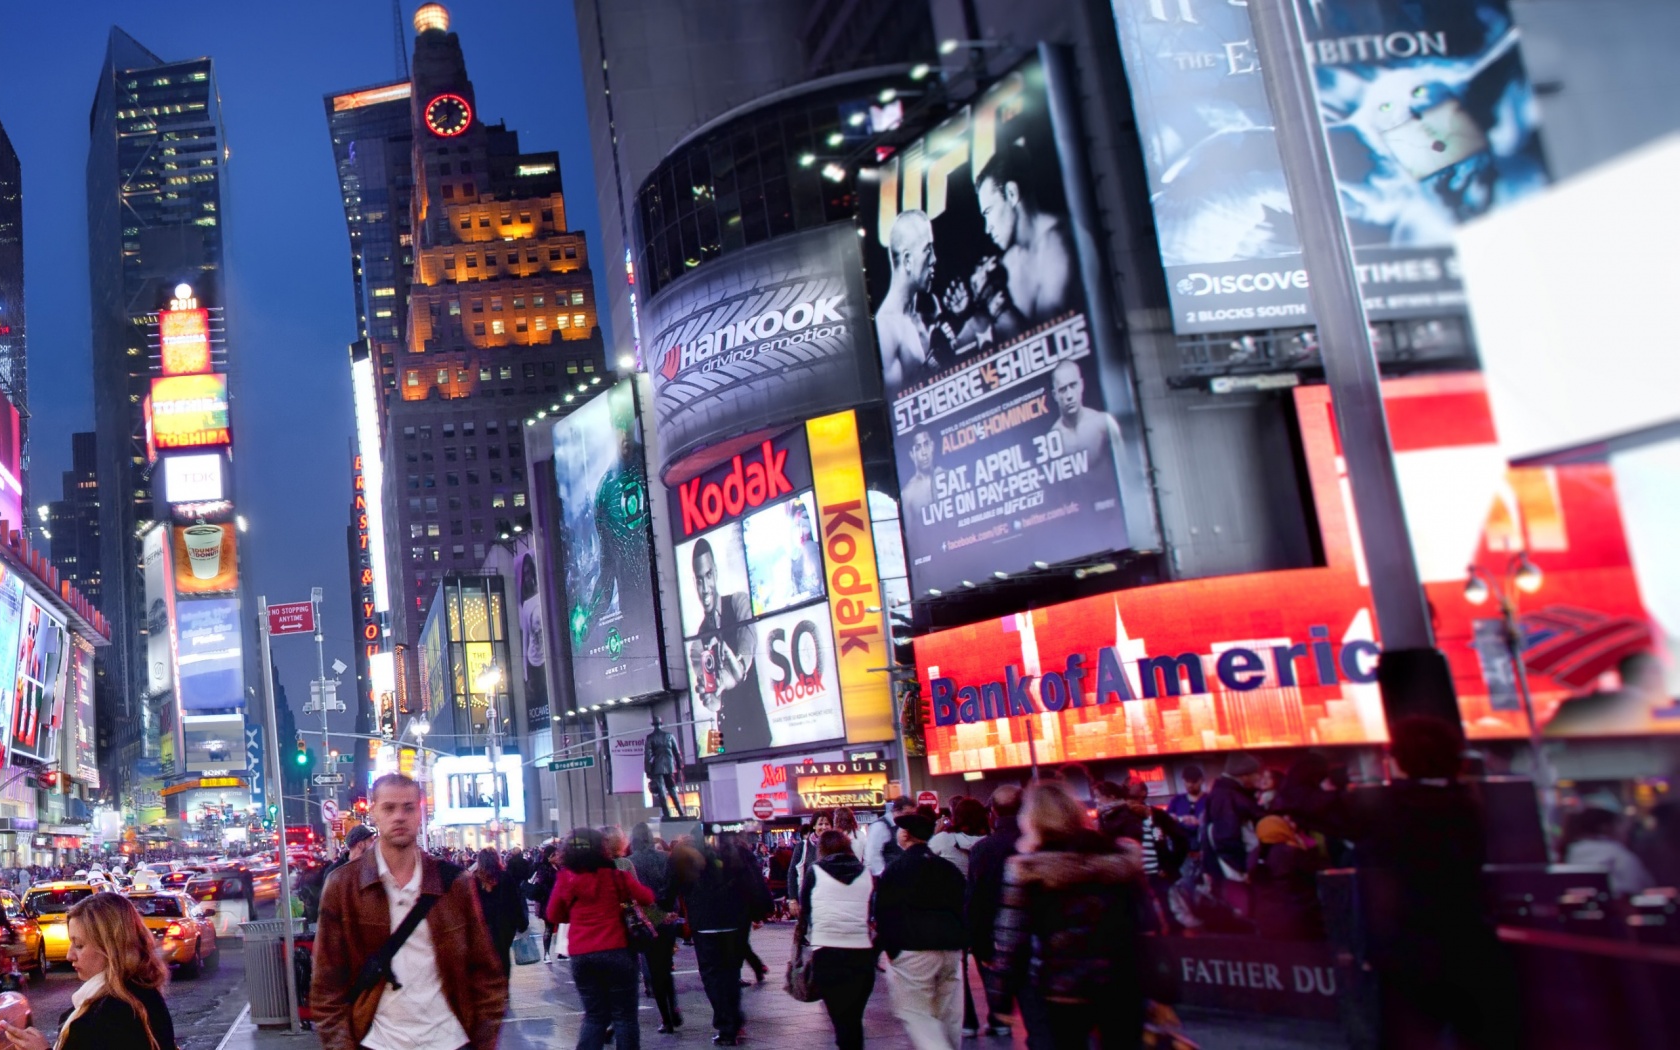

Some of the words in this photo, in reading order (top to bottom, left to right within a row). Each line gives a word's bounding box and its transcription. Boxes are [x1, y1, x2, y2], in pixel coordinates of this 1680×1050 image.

[1199, 308, 1254, 321] BLOCKS
[1257, 304, 1307, 318] SOUTH
[703, 346, 754, 374] driving
[758, 325, 846, 354] emotion
[894, 368, 984, 430] ST-PIERRE
[996, 322, 1090, 386] SHIELDS
[984, 394, 1050, 438] HOMINICK
[156, 429, 230, 448] TOSHIBA
[935, 464, 971, 499] SAT.
[975, 444, 1031, 487] APRIL
[1033, 430, 1063, 464] 30
[678, 439, 794, 537] Kodak
[922, 499, 954, 526] LIVE
[955, 490, 976, 515] ON
[977, 450, 1088, 509] PAY-PER-VIEW
[822, 500, 875, 658] Kodak
[271, 608, 280, 616] NO
[281, 605, 309, 614] STOPPING
[278, 614, 303, 622] ANYTIME
[773, 668, 826, 706] Kodak
[931, 665, 1031, 727] Bank
[1039, 653, 1087, 712] of
[1096, 625, 1381, 705] Americ
[615, 739, 645, 748] Marriot
[554, 758, 588, 771] Broadway
[795, 761, 887, 775] MARQUIS
[801, 789, 885, 809] WONDERLAND
[1181, 957, 1284, 990] FATHER
